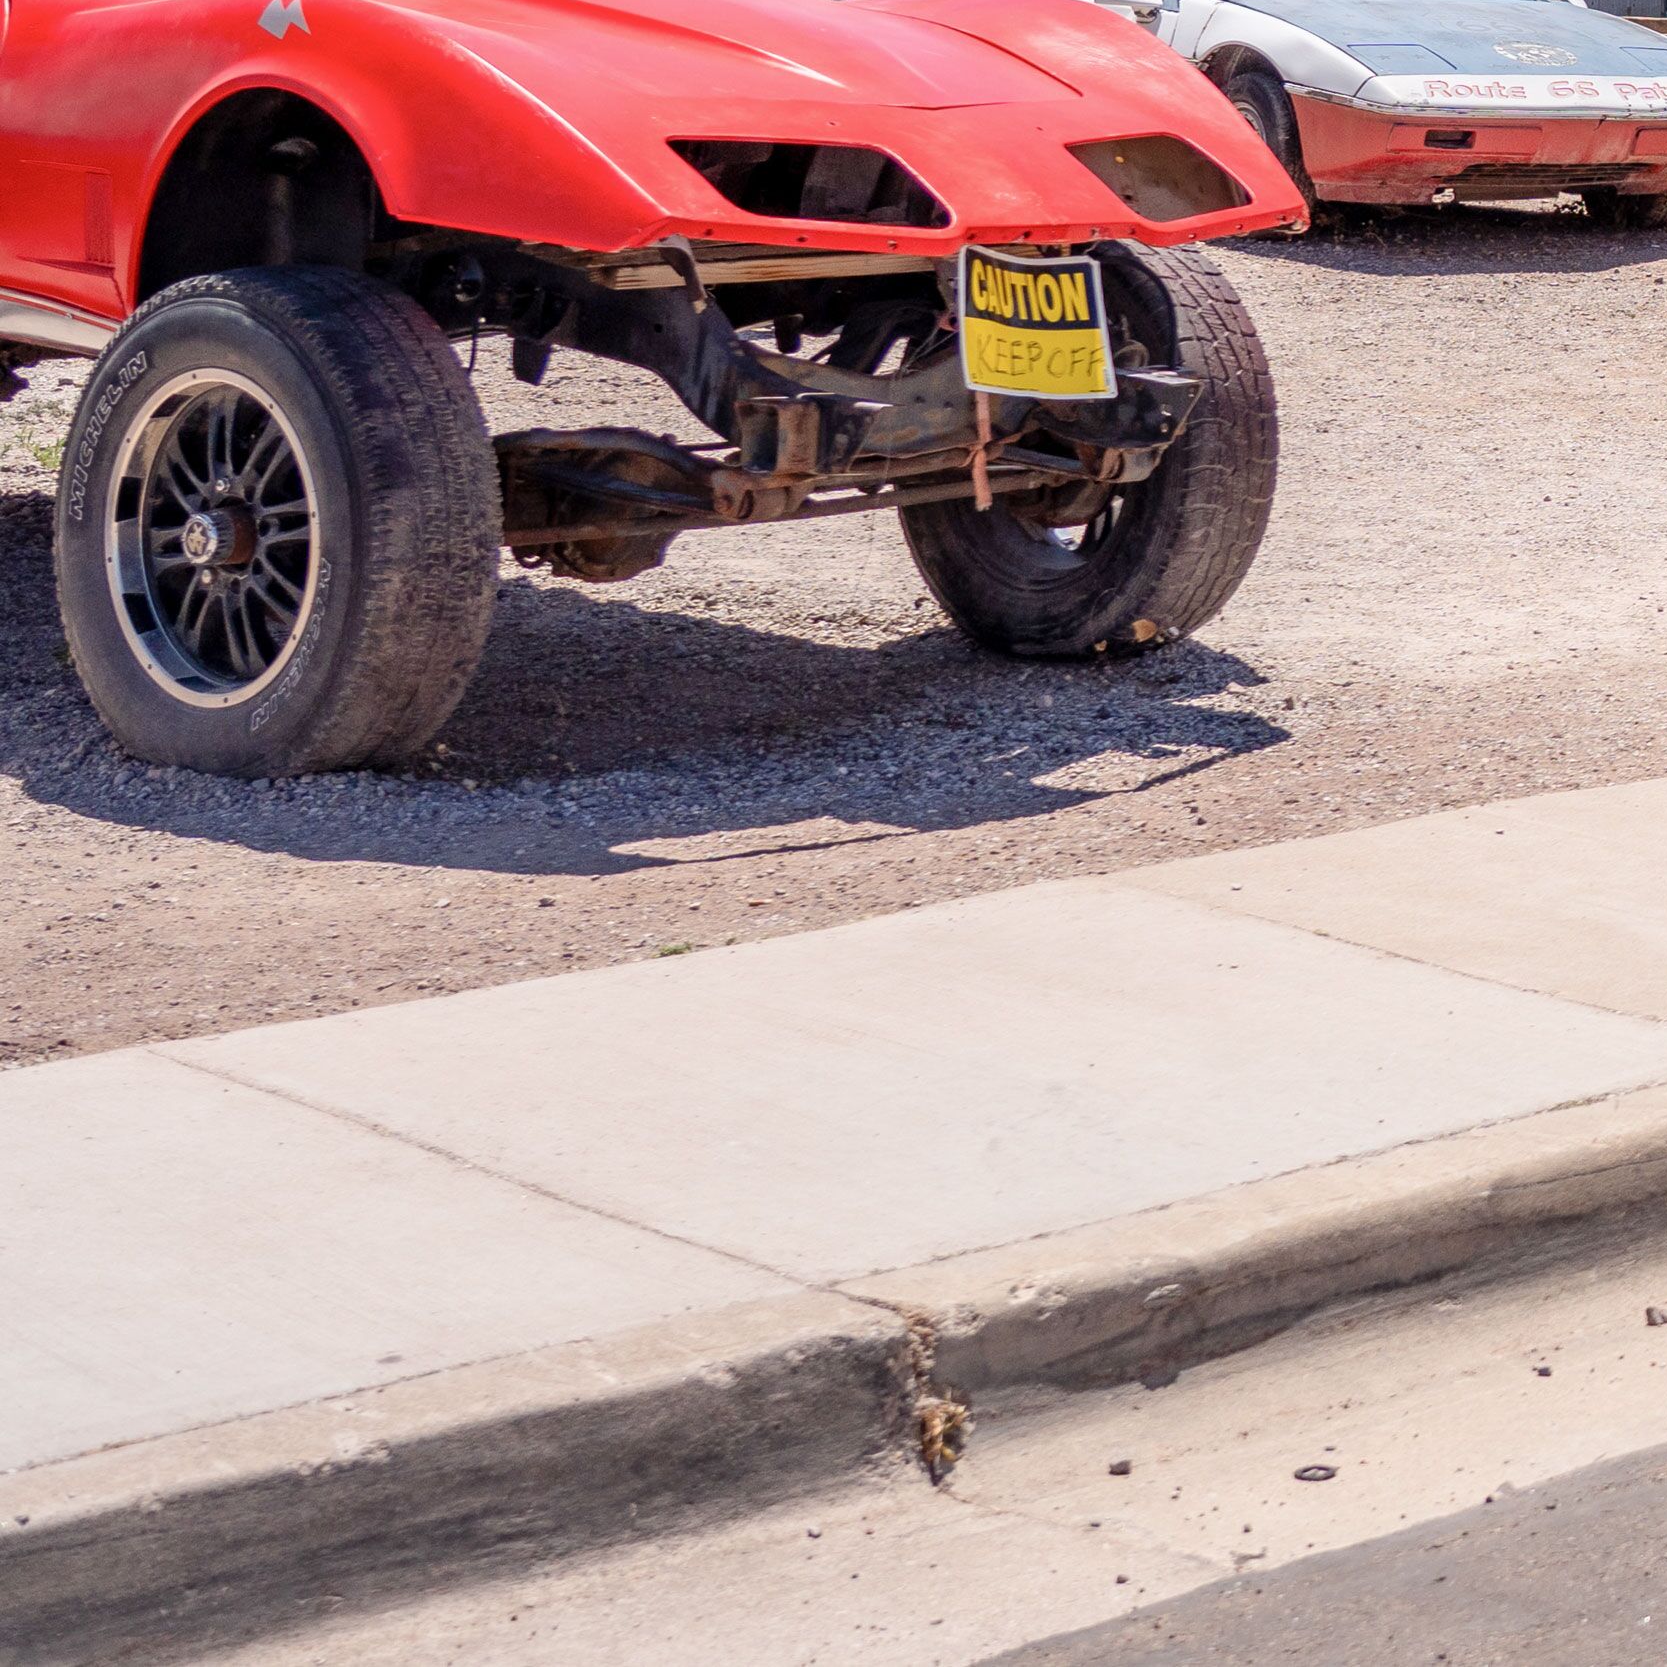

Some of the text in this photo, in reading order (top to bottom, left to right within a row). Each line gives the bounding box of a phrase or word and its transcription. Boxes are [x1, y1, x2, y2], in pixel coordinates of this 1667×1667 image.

[1423, 80, 1527, 100] Route
[1547, 80, 1600, 98] 66
[971, 258, 1090, 322] CAUTION
[978, 334, 1105, 378] KEEP OFF
[69, 350, 148, 520] MICHELIN
